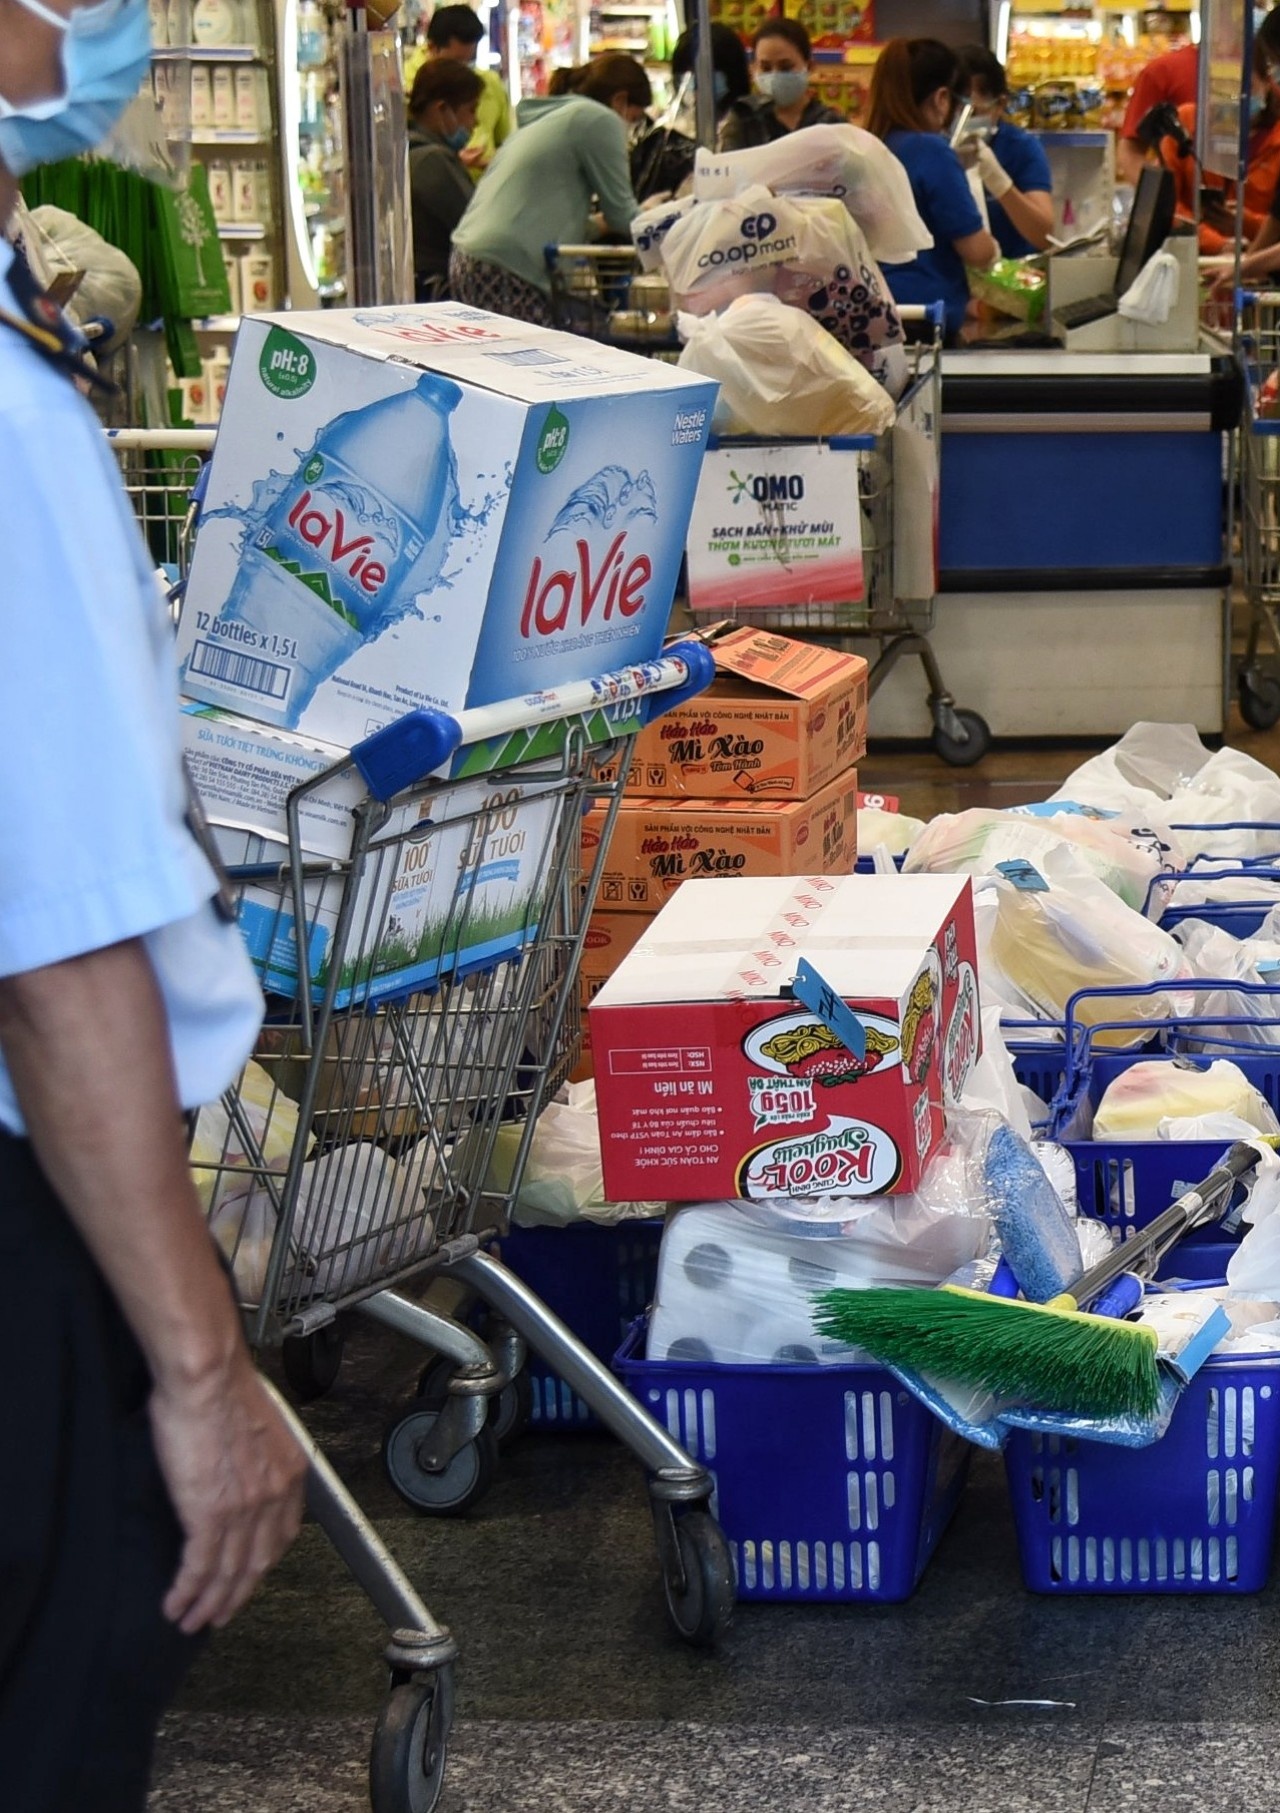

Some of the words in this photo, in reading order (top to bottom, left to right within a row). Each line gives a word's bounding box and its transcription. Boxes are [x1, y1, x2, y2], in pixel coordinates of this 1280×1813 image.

[271, 349, 309, 376] pH:8
[261, 367, 280, 393] natural
[280, 378, 312, 397] alkalinity
[673, 409, 707, 431] Nestlé
[543, 426, 567, 452] pH:8
[671, 430, 703, 447] Waters
[752, 474, 804, 500] OMO
[810, 521, 834, 534] MÙI
[288, 489, 387, 593] laVie
[520, 531, 652, 639] laVie
[195, 611, 208, 631] 12
[211, 619, 258, 646] bottles
[259, 637, 267, 650] x
[712, 709, 732, 720] CÔNG
[660, 720, 688, 740] Hảo
[690, 717, 718, 737] Hảo
[669, 737, 705, 764] Mì
[708, 734, 764, 761] Xào
[644, 824, 658, 833] SẢN
[693, 824, 713, 834] CÔNG
[641, 836, 669, 854] Hảo
[671, 833, 699, 851] Hảo
[650, 852, 687, 877] Mì
[689, 848, 745, 873] Xào
[654, 1081, 677, 1098] liền
[679, 1081, 695, 1095] ăn
[697, 1080, 713, 1095] Mì
[760, 1092, 814, 1113] 105g
[610, 1132, 629, 1140] theo
[630, 1132, 650, 1140] VSTP
[672, 1130, 683, 1138] An
[644, 1146, 666, 1155] ĐÌNH
[667, 1145, 683, 1153] GIA
[700, 1144, 719, 1153] CHO
[774, 1128, 867, 1164] Spaghetti
[661, 1157, 678, 1168] SỨC
[680, 1156, 705, 1166] TOÀN
[708, 1156, 720, 1164] AN
[764, 1143, 875, 1190] KOOL
[810, 1178, 835, 1189] CUNG
